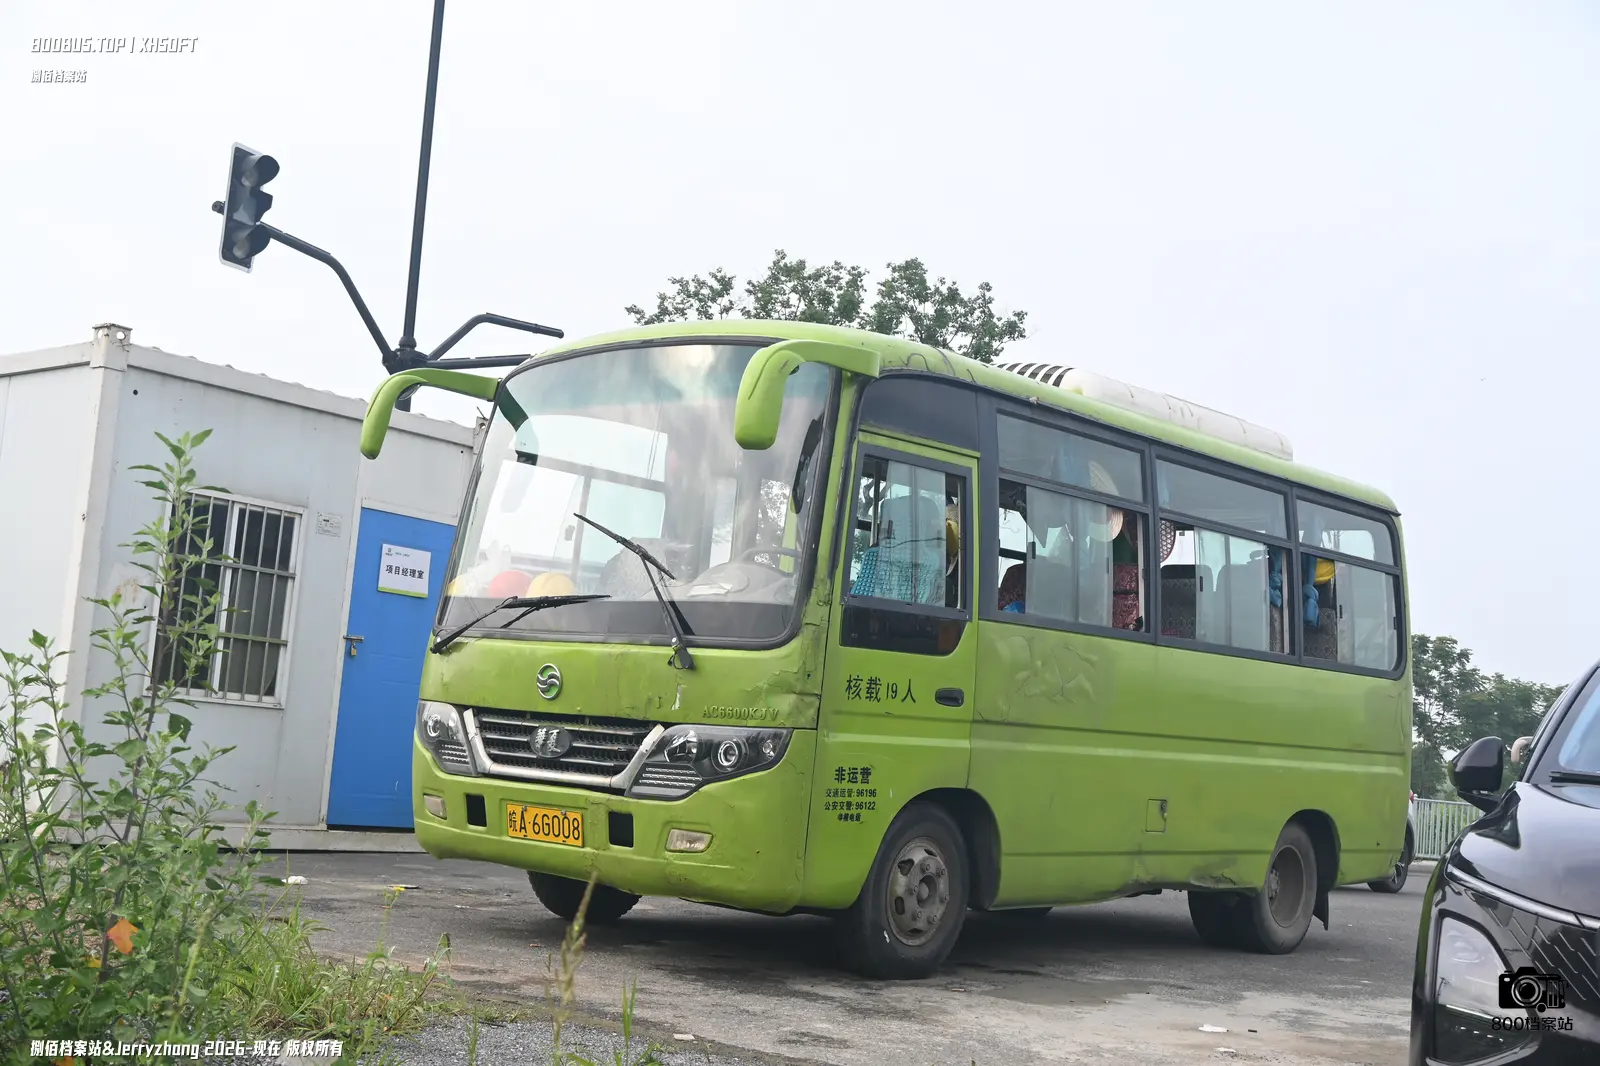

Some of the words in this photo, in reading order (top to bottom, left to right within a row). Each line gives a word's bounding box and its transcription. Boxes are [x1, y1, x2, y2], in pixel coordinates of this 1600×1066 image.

[385, 564, 425, 580] 项目经理室
[845, 674, 917, 703] 核载19人
[702, 705, 779, 721] AC6600KJV
[834, 766, 872, 785] 非运营
